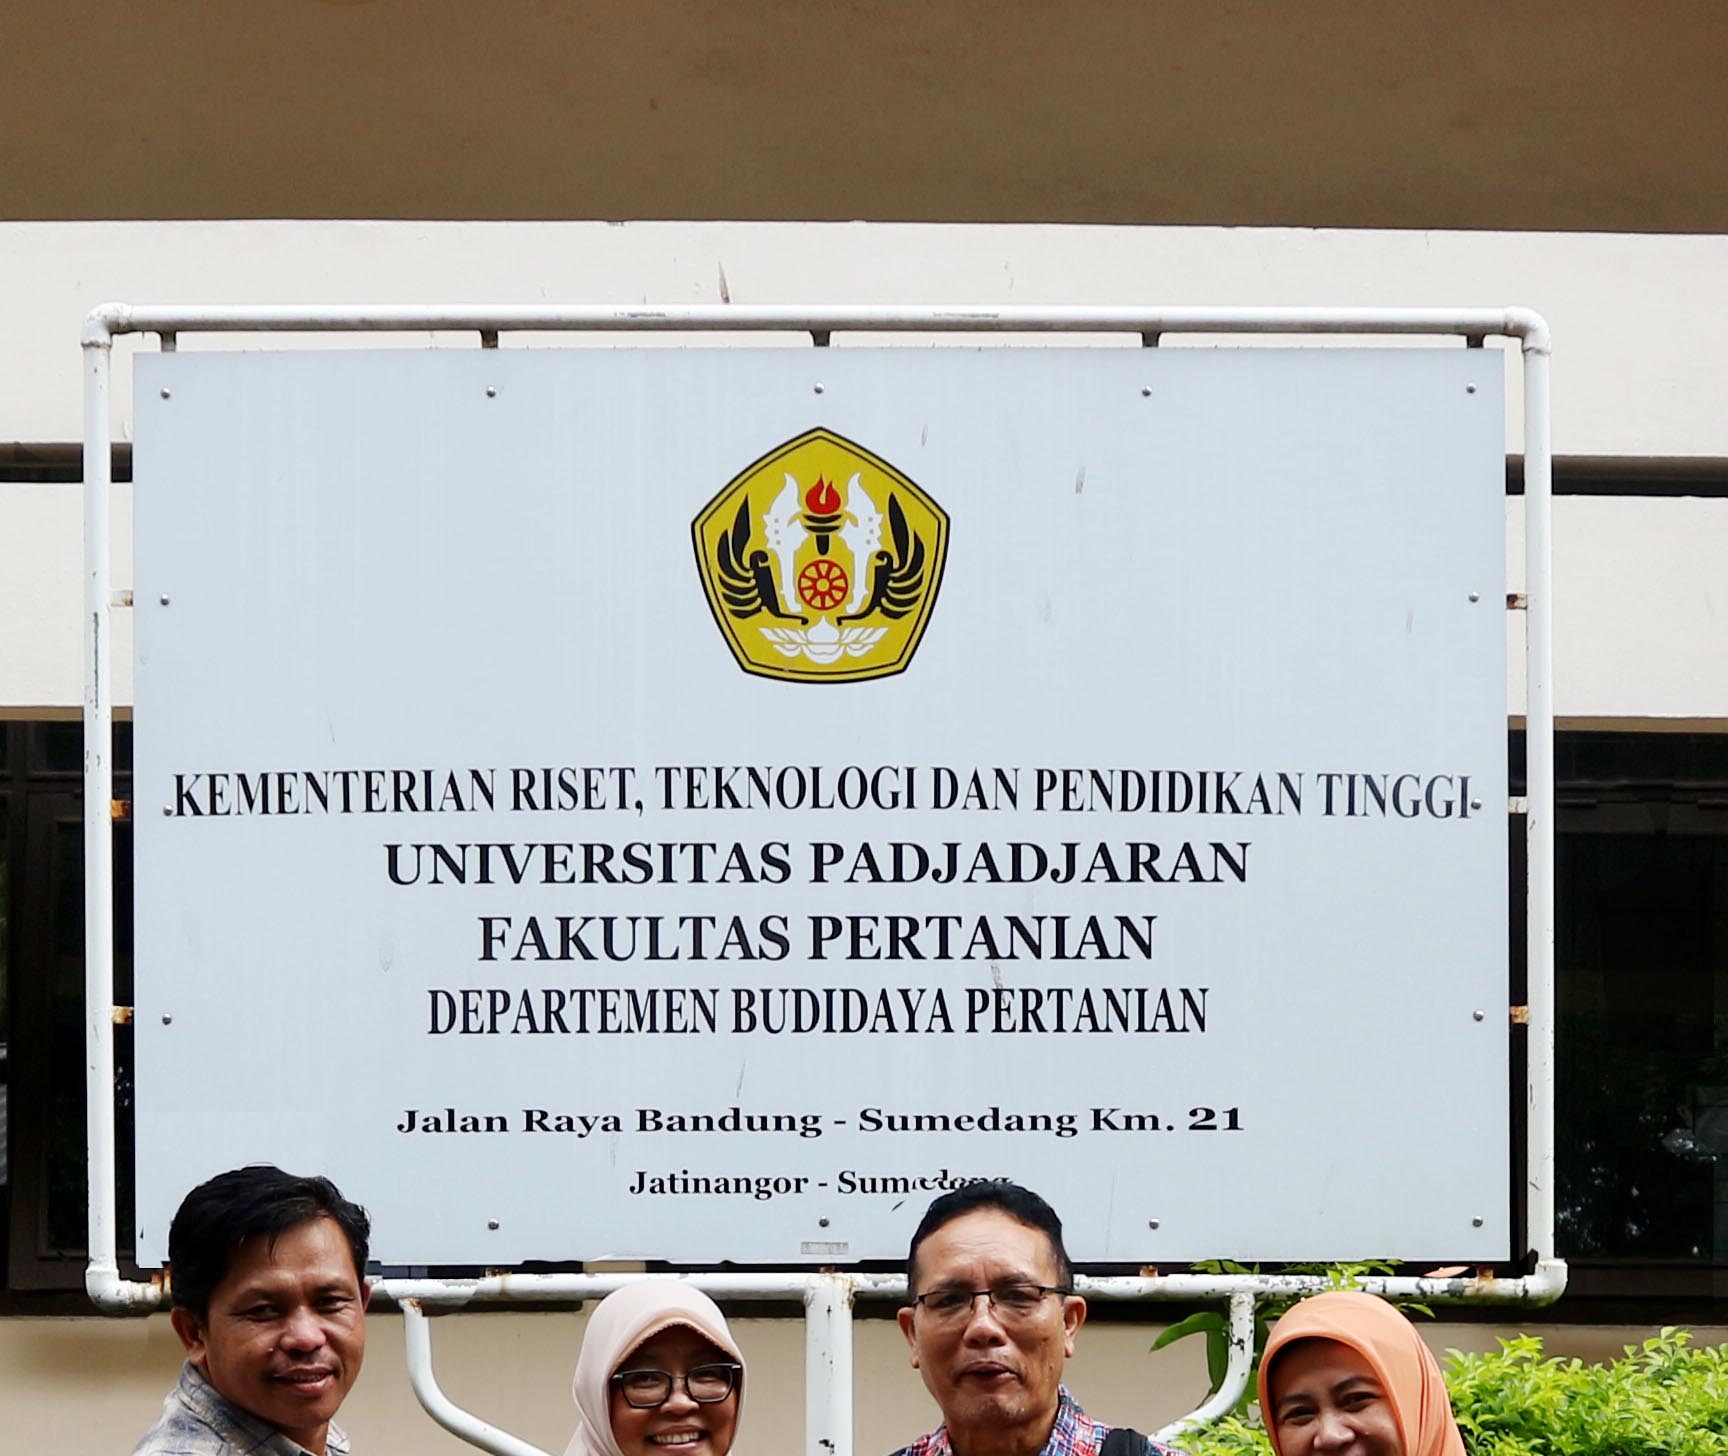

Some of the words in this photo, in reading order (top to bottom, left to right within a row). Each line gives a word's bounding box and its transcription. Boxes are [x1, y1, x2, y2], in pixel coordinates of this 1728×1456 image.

[174, 768, 495, 817] KEMENTERIAN
[511, 767, 643, 816] RISET,
[655, 765, 916, 809] TEKNOLOGI
[932, 767, 1019, 810] DAN
[1035, 768, 1303, 815] PENDIDIKAN
[1316, 773, 1469, 819] TINGGI
[384, 841, 791, 885] UNIVERSITAS
[809, 841, 1252, 884] PADJADJARAN
[478, 914, 790, 961] FAKULTAS
[807, 915, 1158, 960] PERTANIAN
[427, 988, 720, 1034] DEPARTEMEN
[731, 987, 954, 1034] BUDIDAYA
[965, 987, 1209, 1033] PERTANIAN
[396, 1108, 509, 1133] Jalan
[522, 1109, 622, 1138] Raya
[636, 1107, 822, 1138] Bandung
[859, 1106, 1078, 1137] Sumedang
[1090, 1107, 1175, 1131] Km.
[1188, 1107, 1244, 1131] 21
[629, 1169, 809, 1200] Jatinangor
